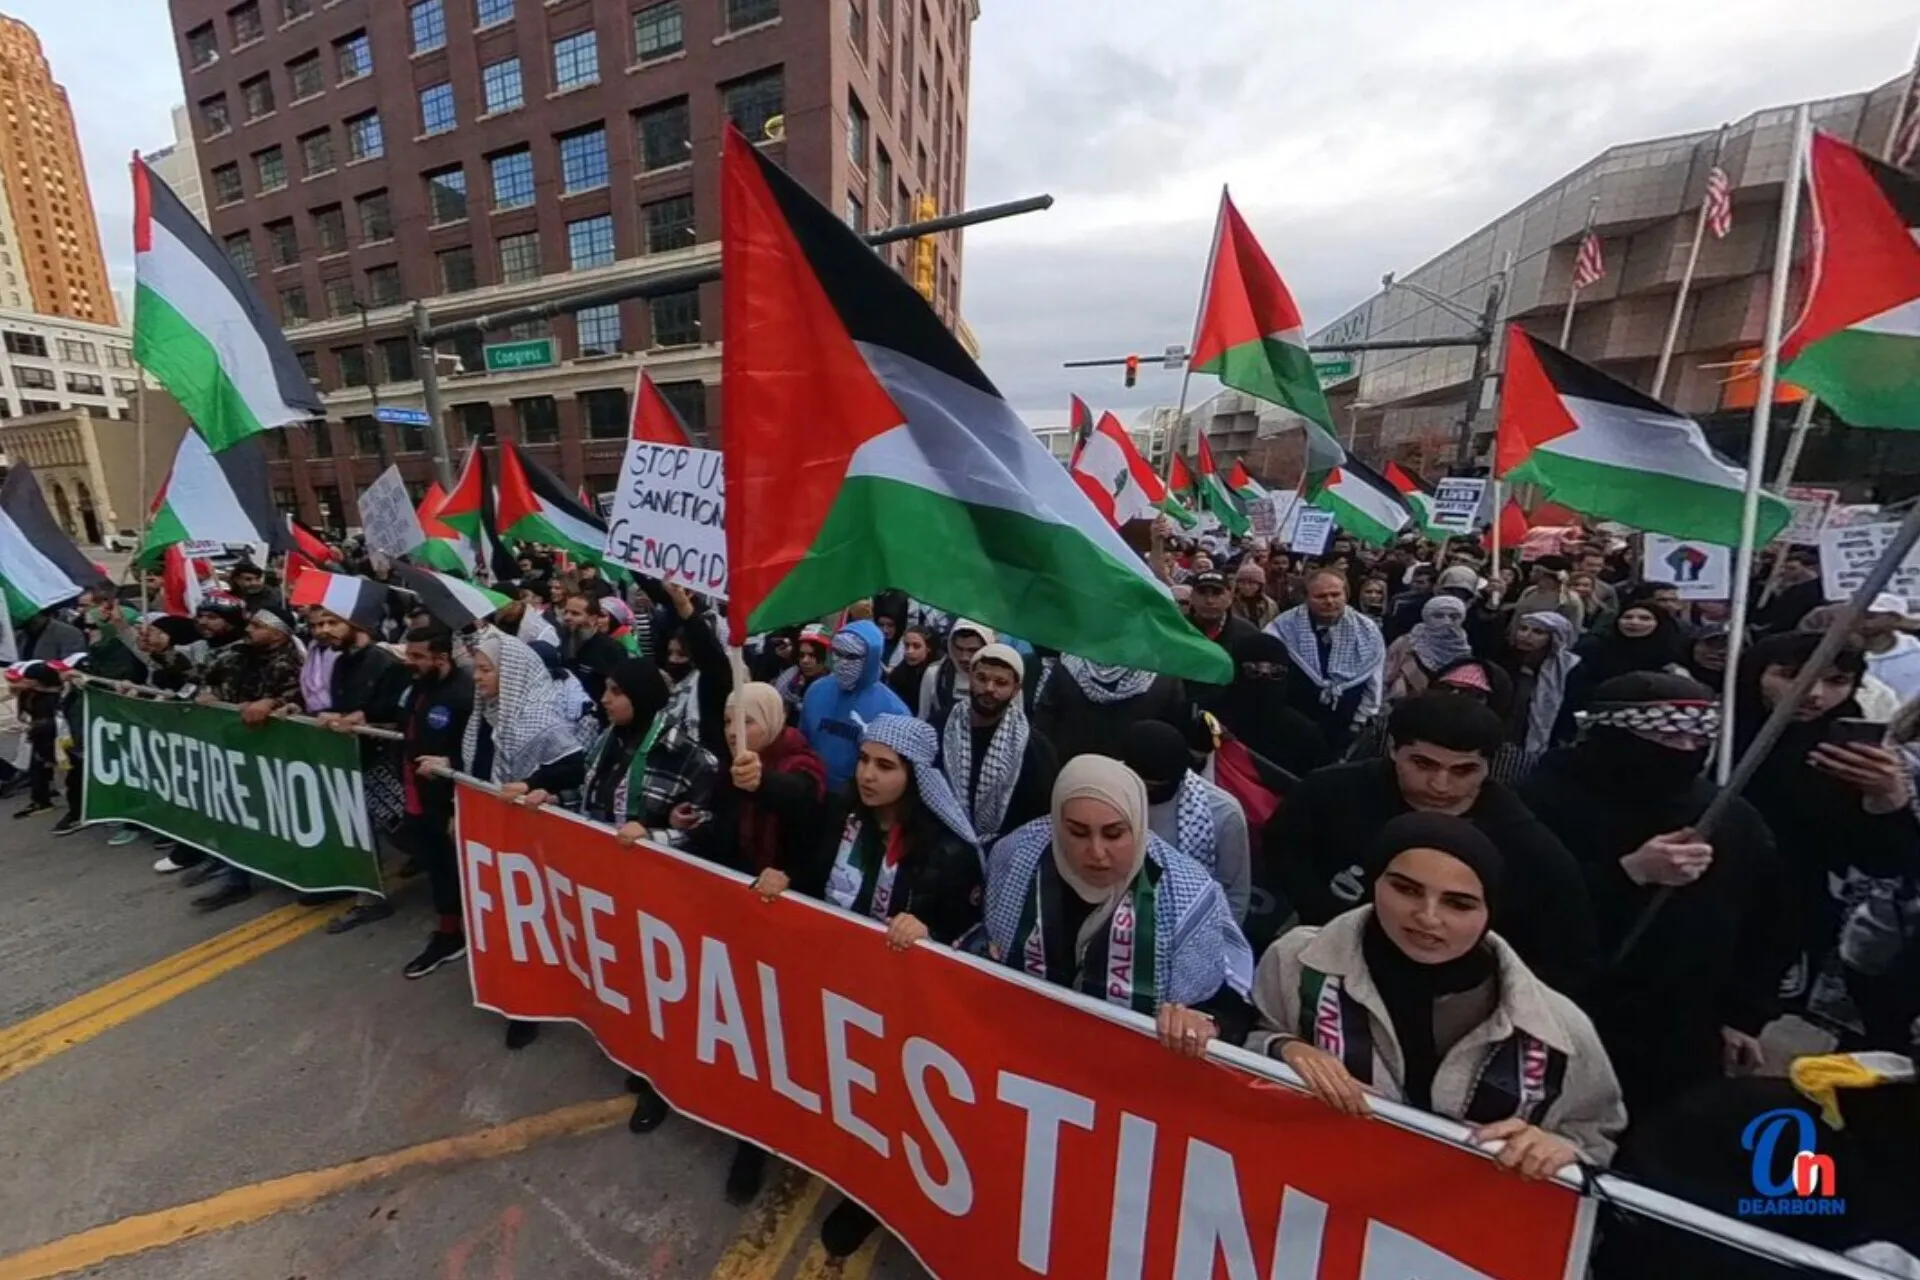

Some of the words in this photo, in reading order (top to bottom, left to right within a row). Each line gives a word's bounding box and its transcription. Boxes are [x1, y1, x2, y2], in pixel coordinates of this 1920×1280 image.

[495, 347, 542, 366] Congress
[631, 445, 689, 480] STOP
[608, 528, 728, 593] GENOCID
[256, 755, 373, 851] NOW
[465, 841, 631, 1015] FREE
